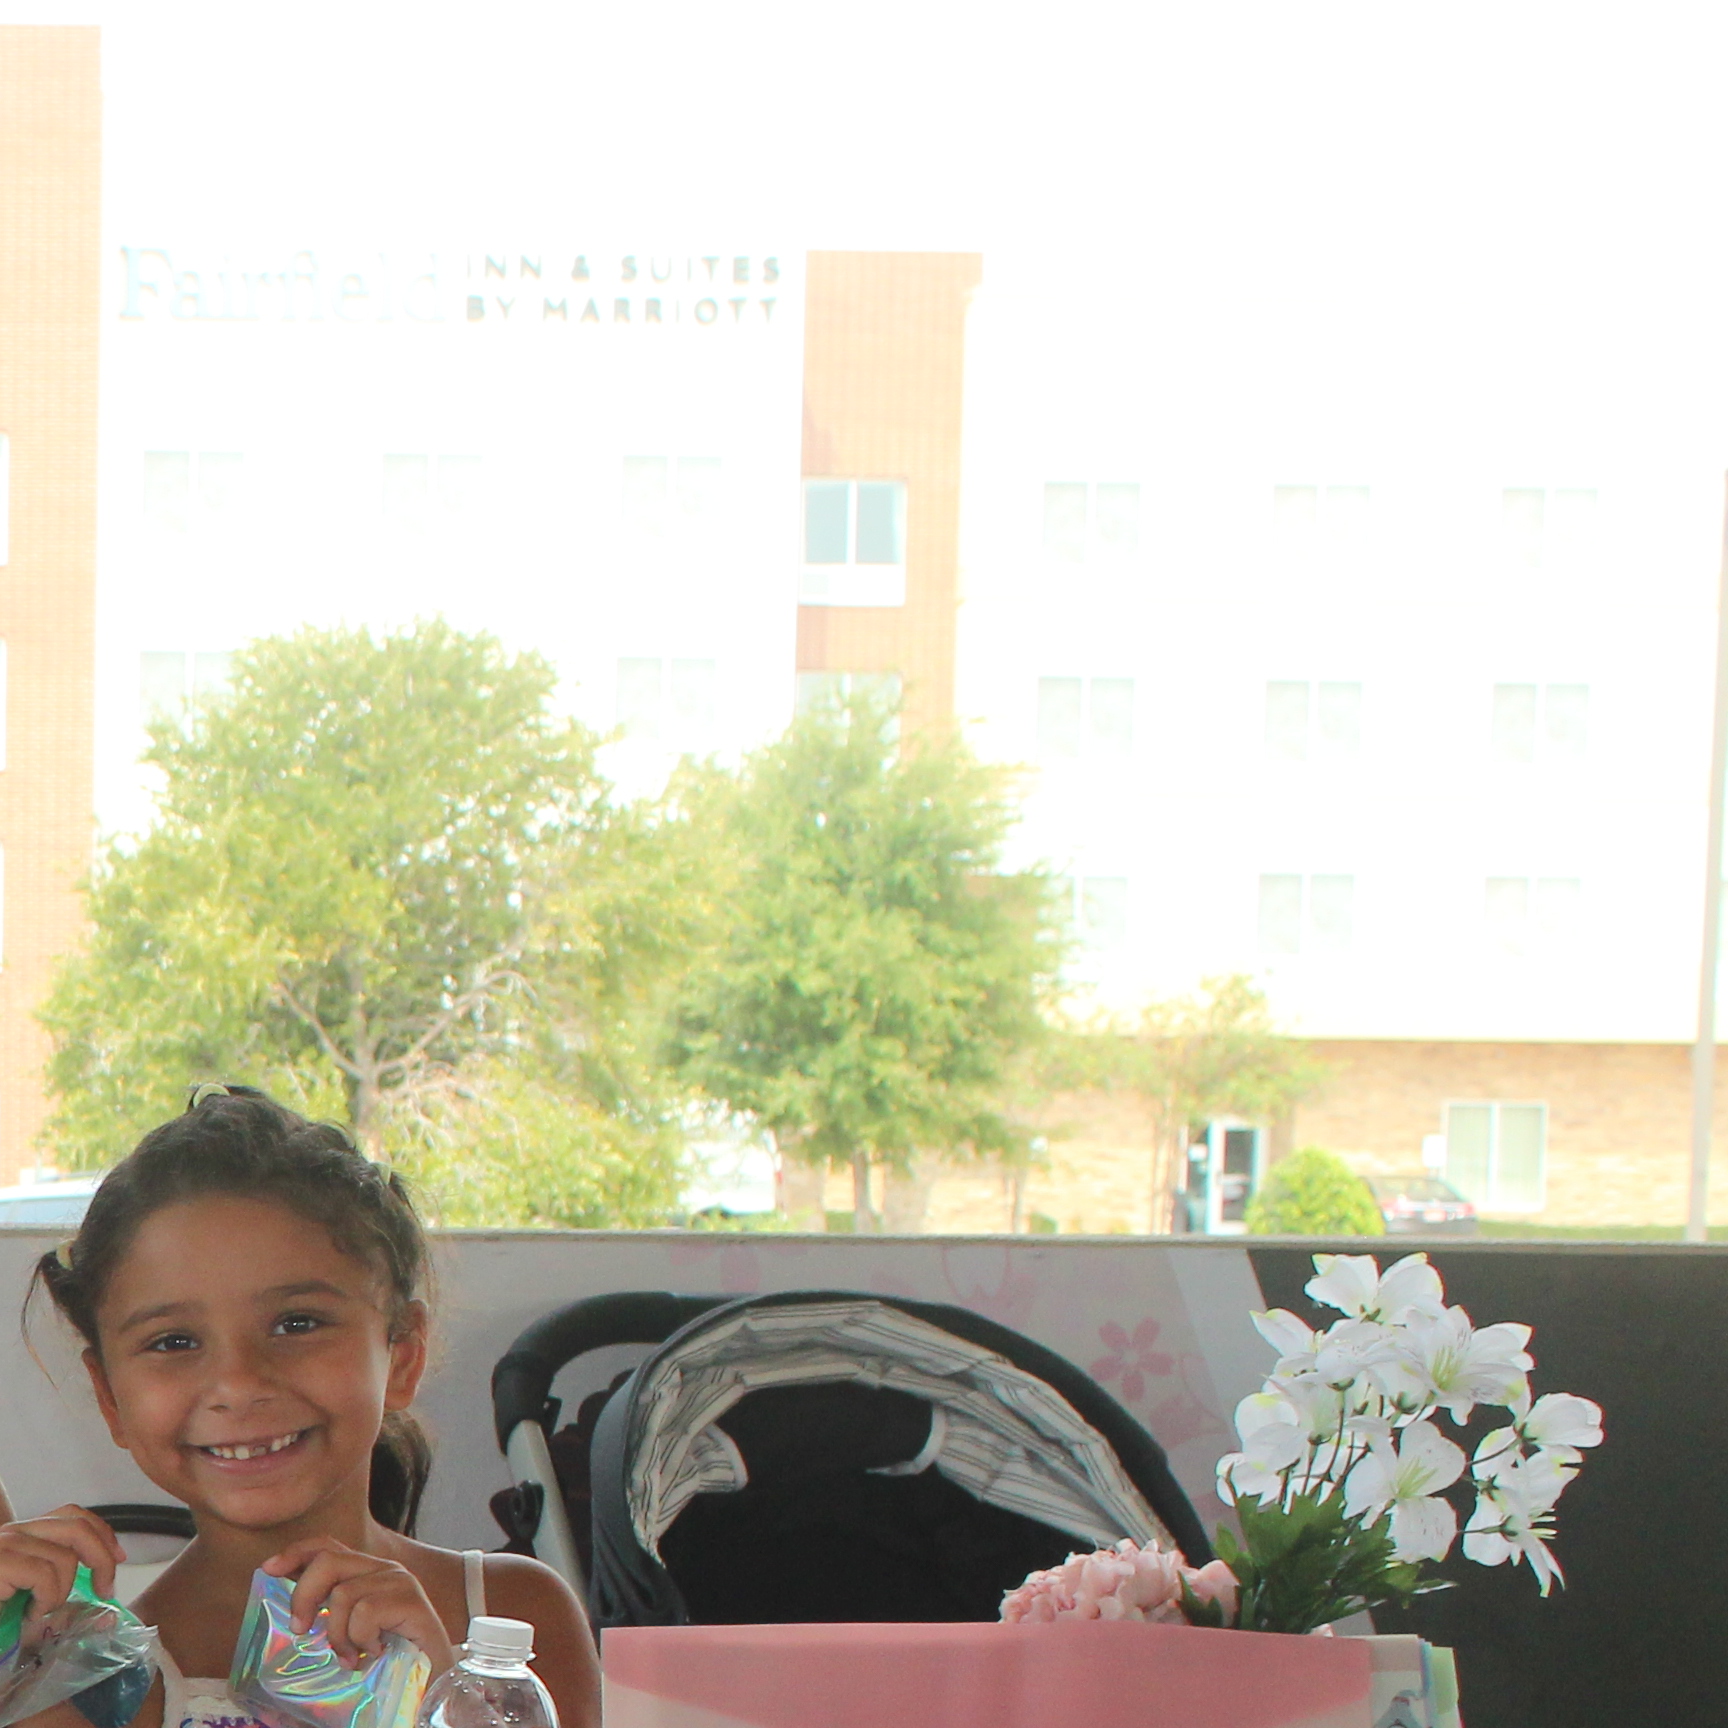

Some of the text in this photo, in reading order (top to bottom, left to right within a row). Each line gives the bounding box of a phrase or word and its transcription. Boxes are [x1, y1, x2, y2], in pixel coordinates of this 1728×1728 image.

[465, 253, 542, 281] INN
[620, 253, 782, 285] SUITES
[465, 293, 782, 325] BY MARRIOTT
